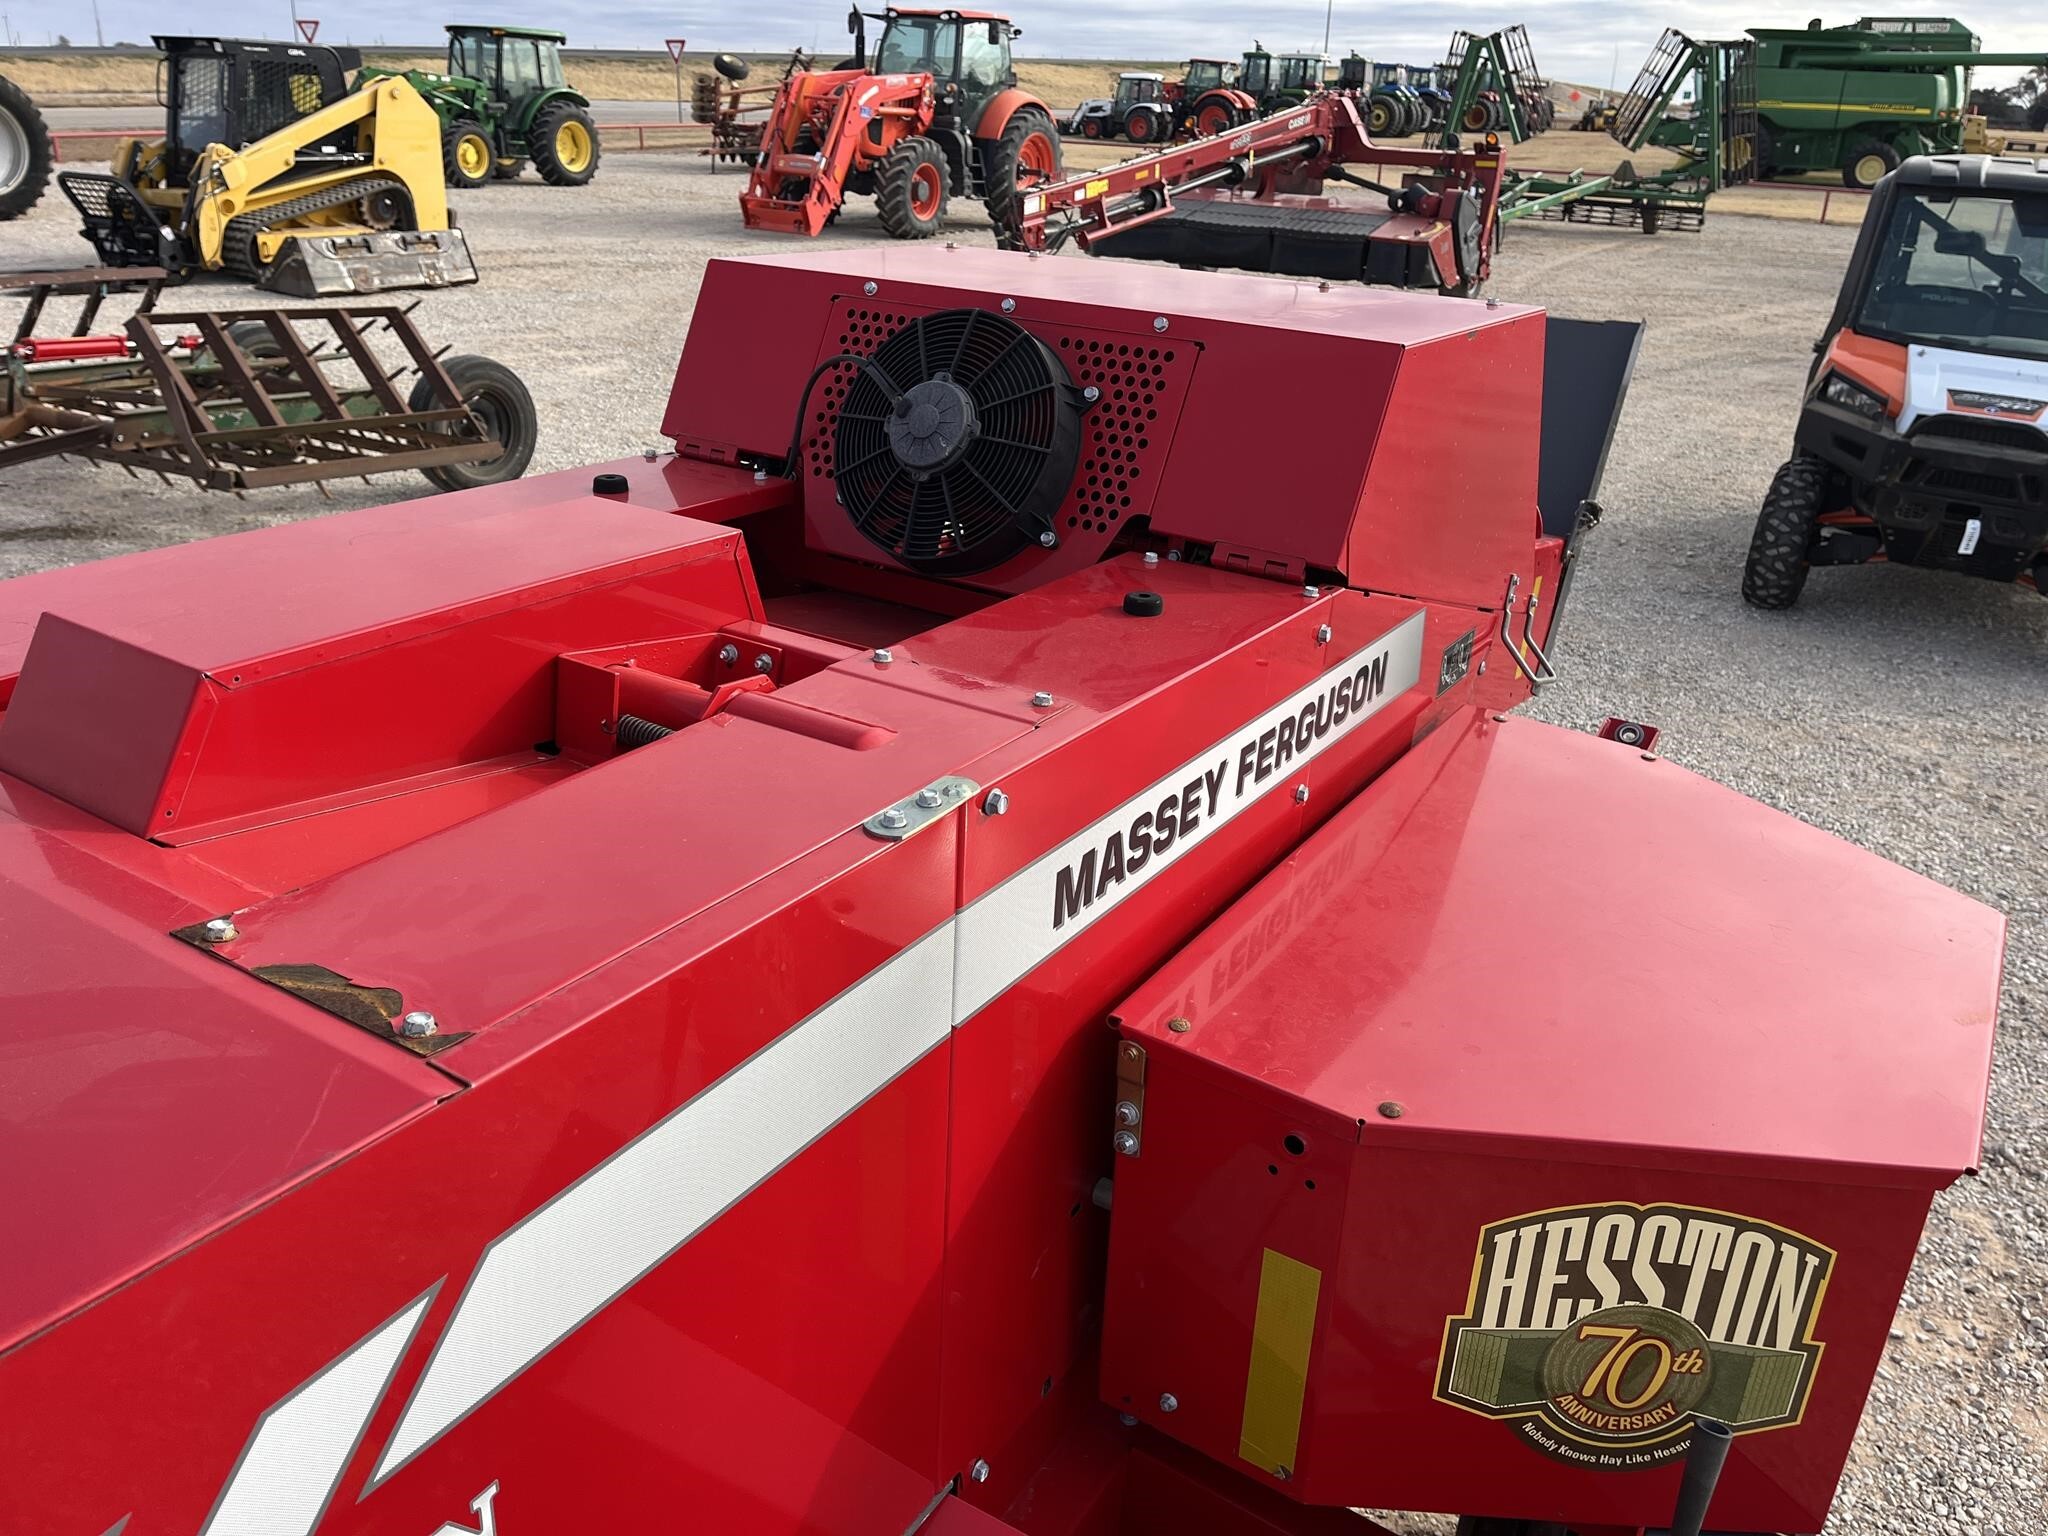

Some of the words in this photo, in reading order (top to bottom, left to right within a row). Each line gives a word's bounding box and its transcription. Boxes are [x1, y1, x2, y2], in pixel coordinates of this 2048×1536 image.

[1053, 759, 1228, 931] MASSEY
[1236, 651, 1389, 798] FERGUSON
[1480, 1214, 1820, 1351] HESSTON
[1522, 1421, 1558, 1453] Nobody
[1557, 1444, 1597, 1464] Knows
[1599, 1456, 1623, 1467] Hay
[1625, 1453, 1651, 1465] Like
[1555, 1394, 1677, 1430] ANNIVERSARY
